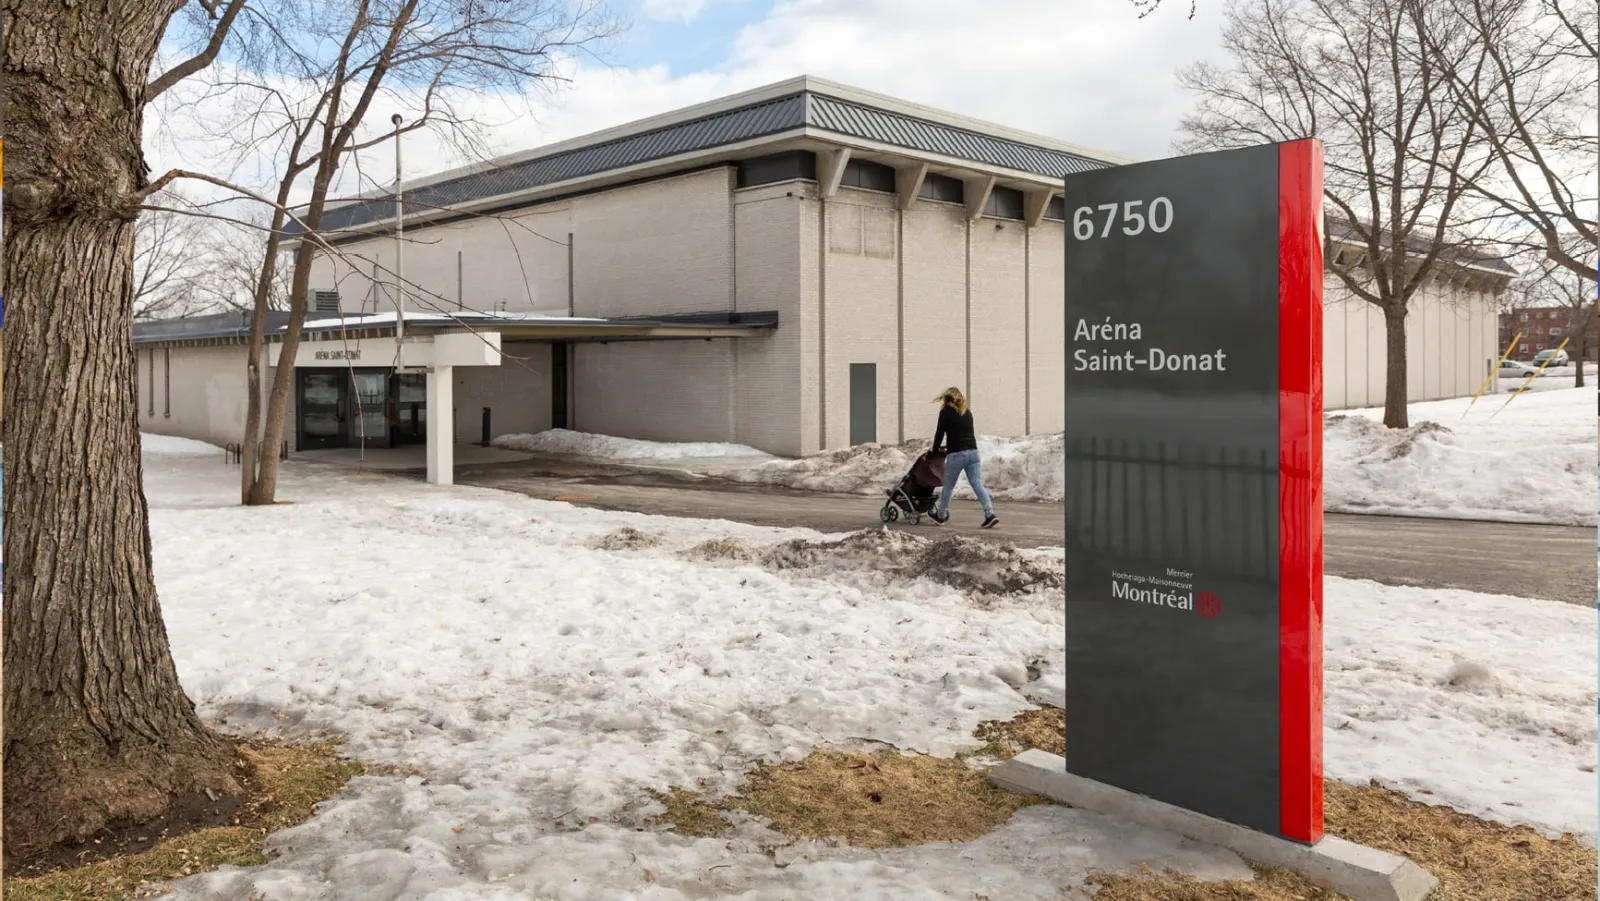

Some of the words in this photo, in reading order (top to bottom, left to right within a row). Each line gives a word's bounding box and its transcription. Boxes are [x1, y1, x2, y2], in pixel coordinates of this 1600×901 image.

[1073, 196, 1174, 241] 6750
[1074, 316, 1142, 341] Aréna
[1074, 348, 1227, 371] Saint-Donat
[1112, 570, 1193, 590] Hochelaga-Maisonneuve
[1166, 567, 1193, 579] Mercier
[1112, 580, 1193, 611] Montréal
